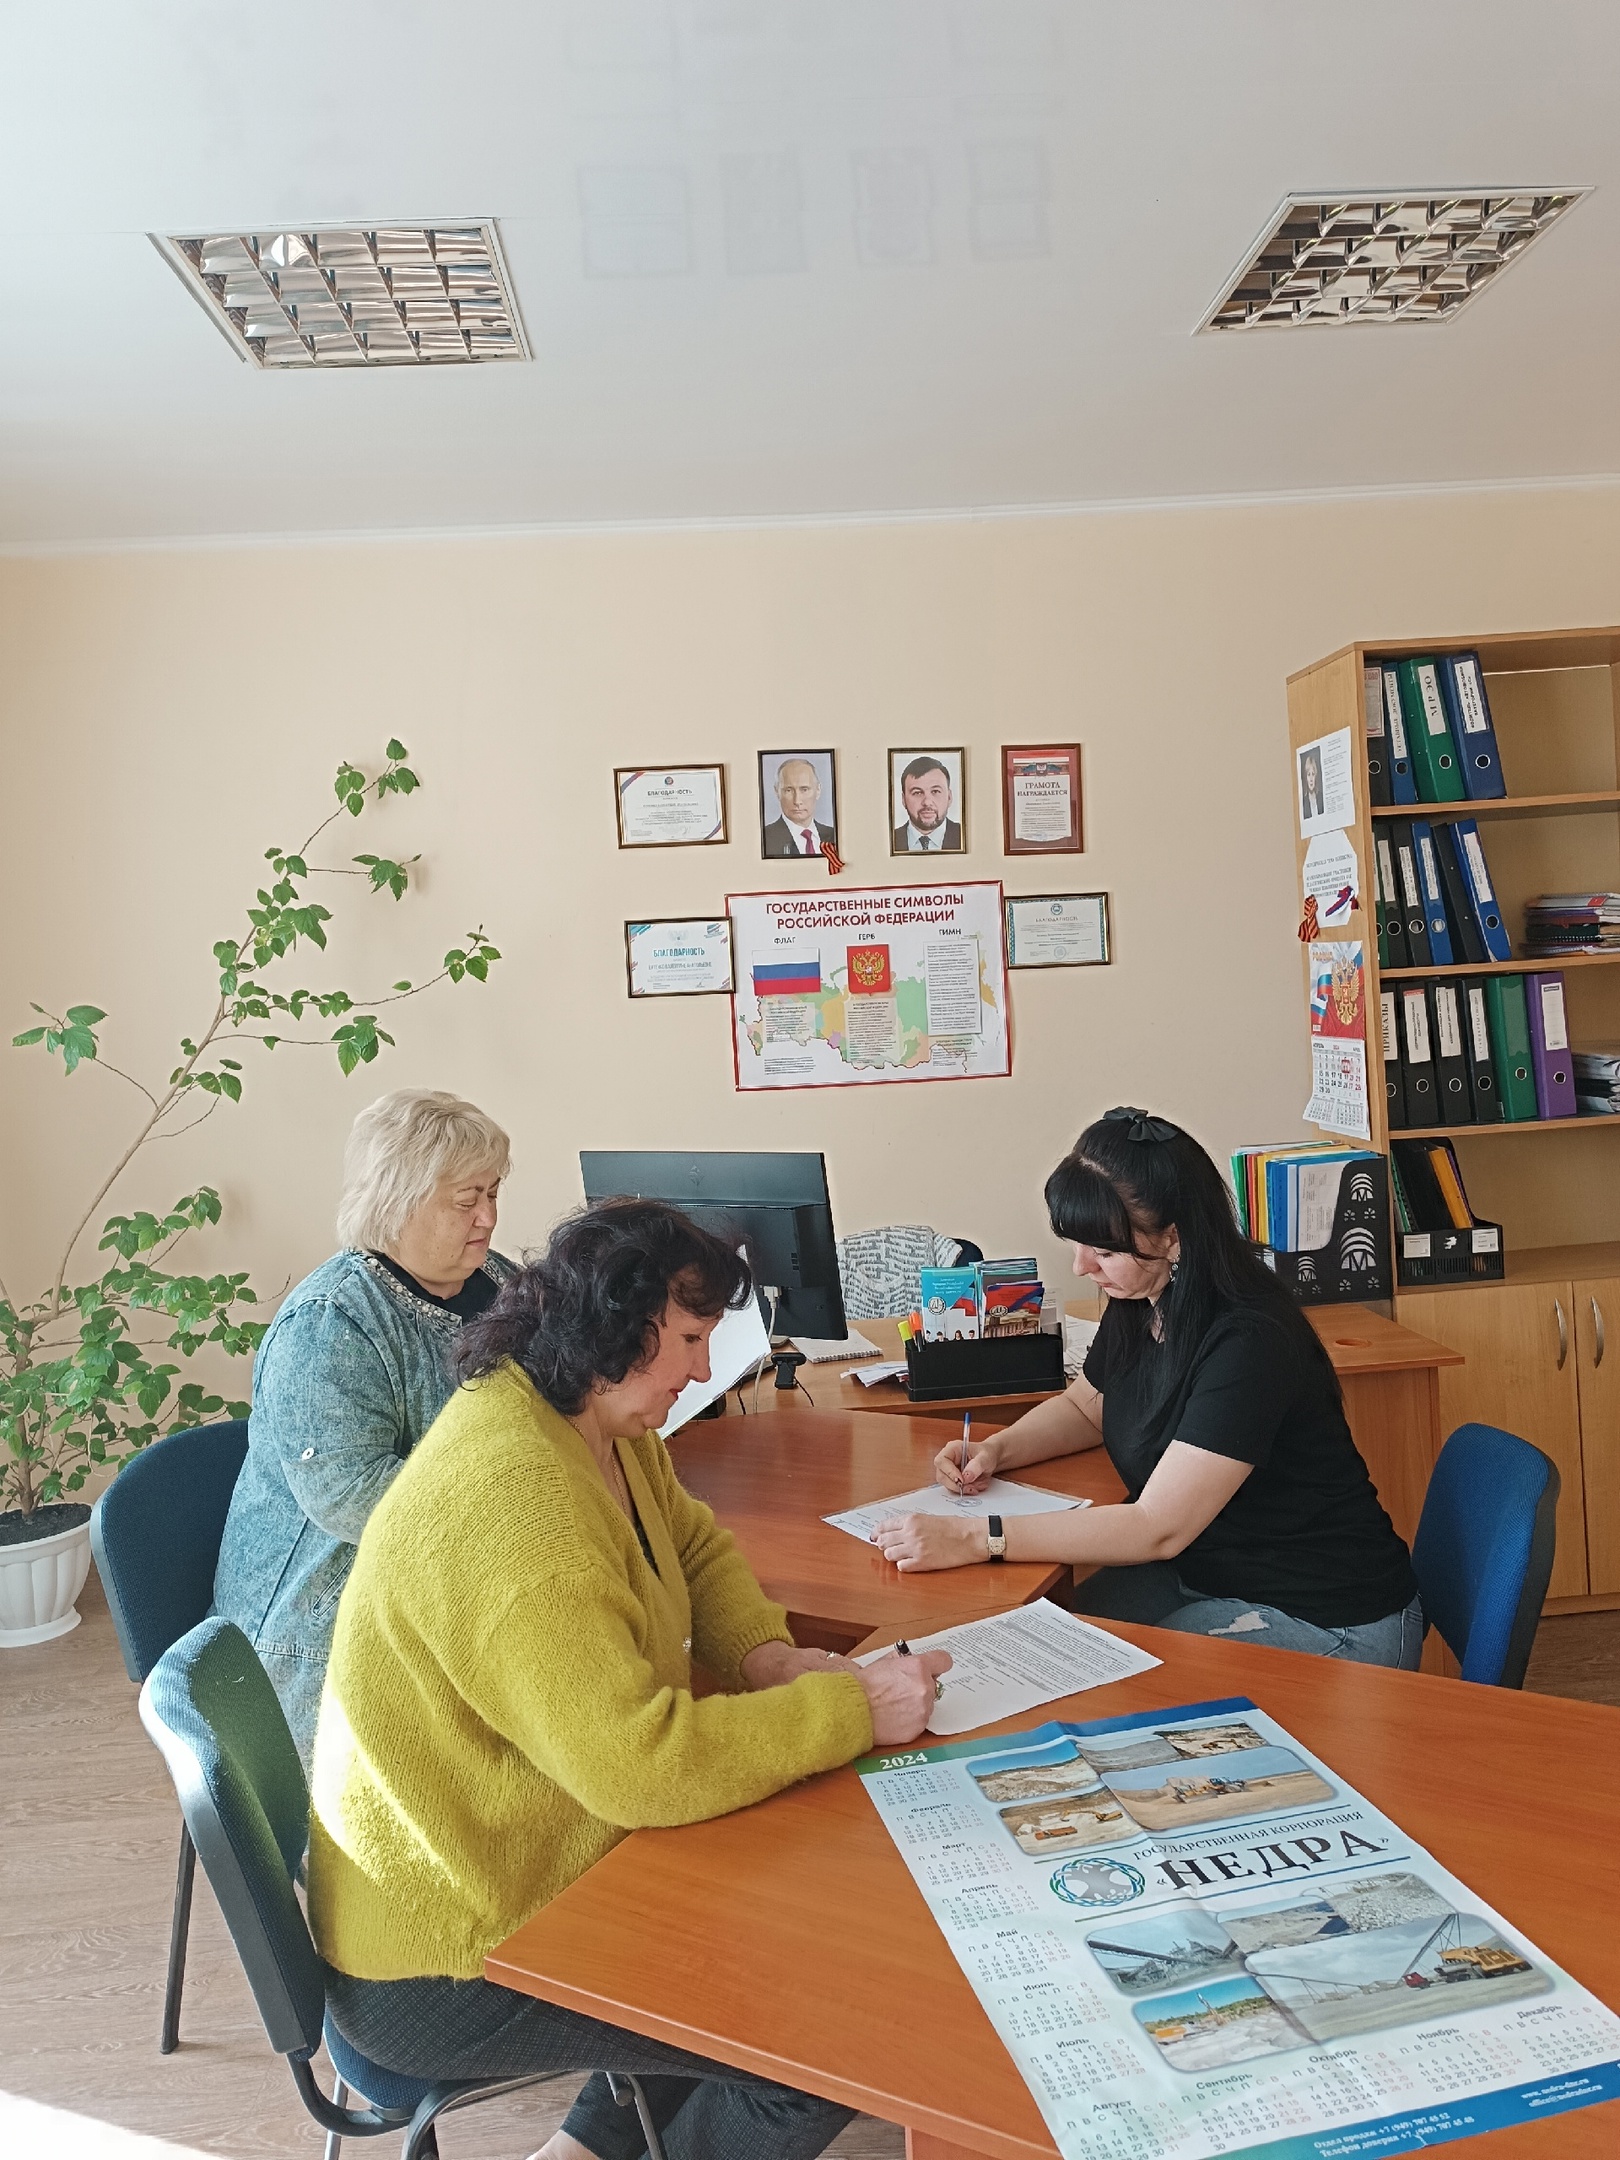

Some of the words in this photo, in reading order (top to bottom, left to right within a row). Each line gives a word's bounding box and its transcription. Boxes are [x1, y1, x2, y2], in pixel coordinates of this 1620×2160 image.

[766, 897, 891, 914] ГОСУДАРСТВЕННЫЕ
[894, 894, 964, 908] СИМВОЛЫ
[777, 913, 871, 929] РОССИЙСКОЙ
[875, 910, 955, 925] ФЕДЕРАЦИИ
[939, 928, 962, 936] ГИМН
[653, 947, 705, 957] БЛАГОДАРНОСТЬ
[1381, 1003, 1391, 1052] ПРИКАЗЫ
[880, 1752, 928, 1769] 2024
[894, 1769, 926, 1777] Январь
[911, 1803, 951, 1813] Февраль
[1133, 1829, 1269, 1861] ГОСУДАРСТВЕННАЯ
[1270, 1811, 1364, 1834] КОРПОРАЦИЯ
[942, 1842, 966, 1850] Март
[1154, 1830, 1390, 1890] «НЕДРА»
[961, 1884, 998, 1894] Апрель
[996, 1928, 1018, 1938] Май
[1023, 1981, 1054, 1991] Июнь
[1516, 2005, 1563, 2019] Декабрь
[1416, 2028, 1459, 2040] Ноябрь
[1056, 2038, 1089, 2049] Июль
[1308, 2049, 1357, 2063] Октябрь
[1060, 2082, 1072, 2090] 23
[1196, 2073, 1253, 2090] Сентябрь
[1347, 2077, 1359, 2085] 10
[1345, 2095, 1358, 2103] 23
[1375, 2088, 1387, 2096] 25
[1093, 2100, 1132, 2112] Август
[1352, 2103, 1365, 2111] 30
[1366, 2100, 1378, 2108] 31
[1313, 2138, 1342, 2149] Отдел
[1378, 2126, 1390, 2134] +7
[1391, 2122, 1413, 2132] (949)
[1320, 2143, 1361, 2158] Телефон
[1362, 2135, 1399, 2149] доверия
[1400, 2131, 1412, 2139] +7
